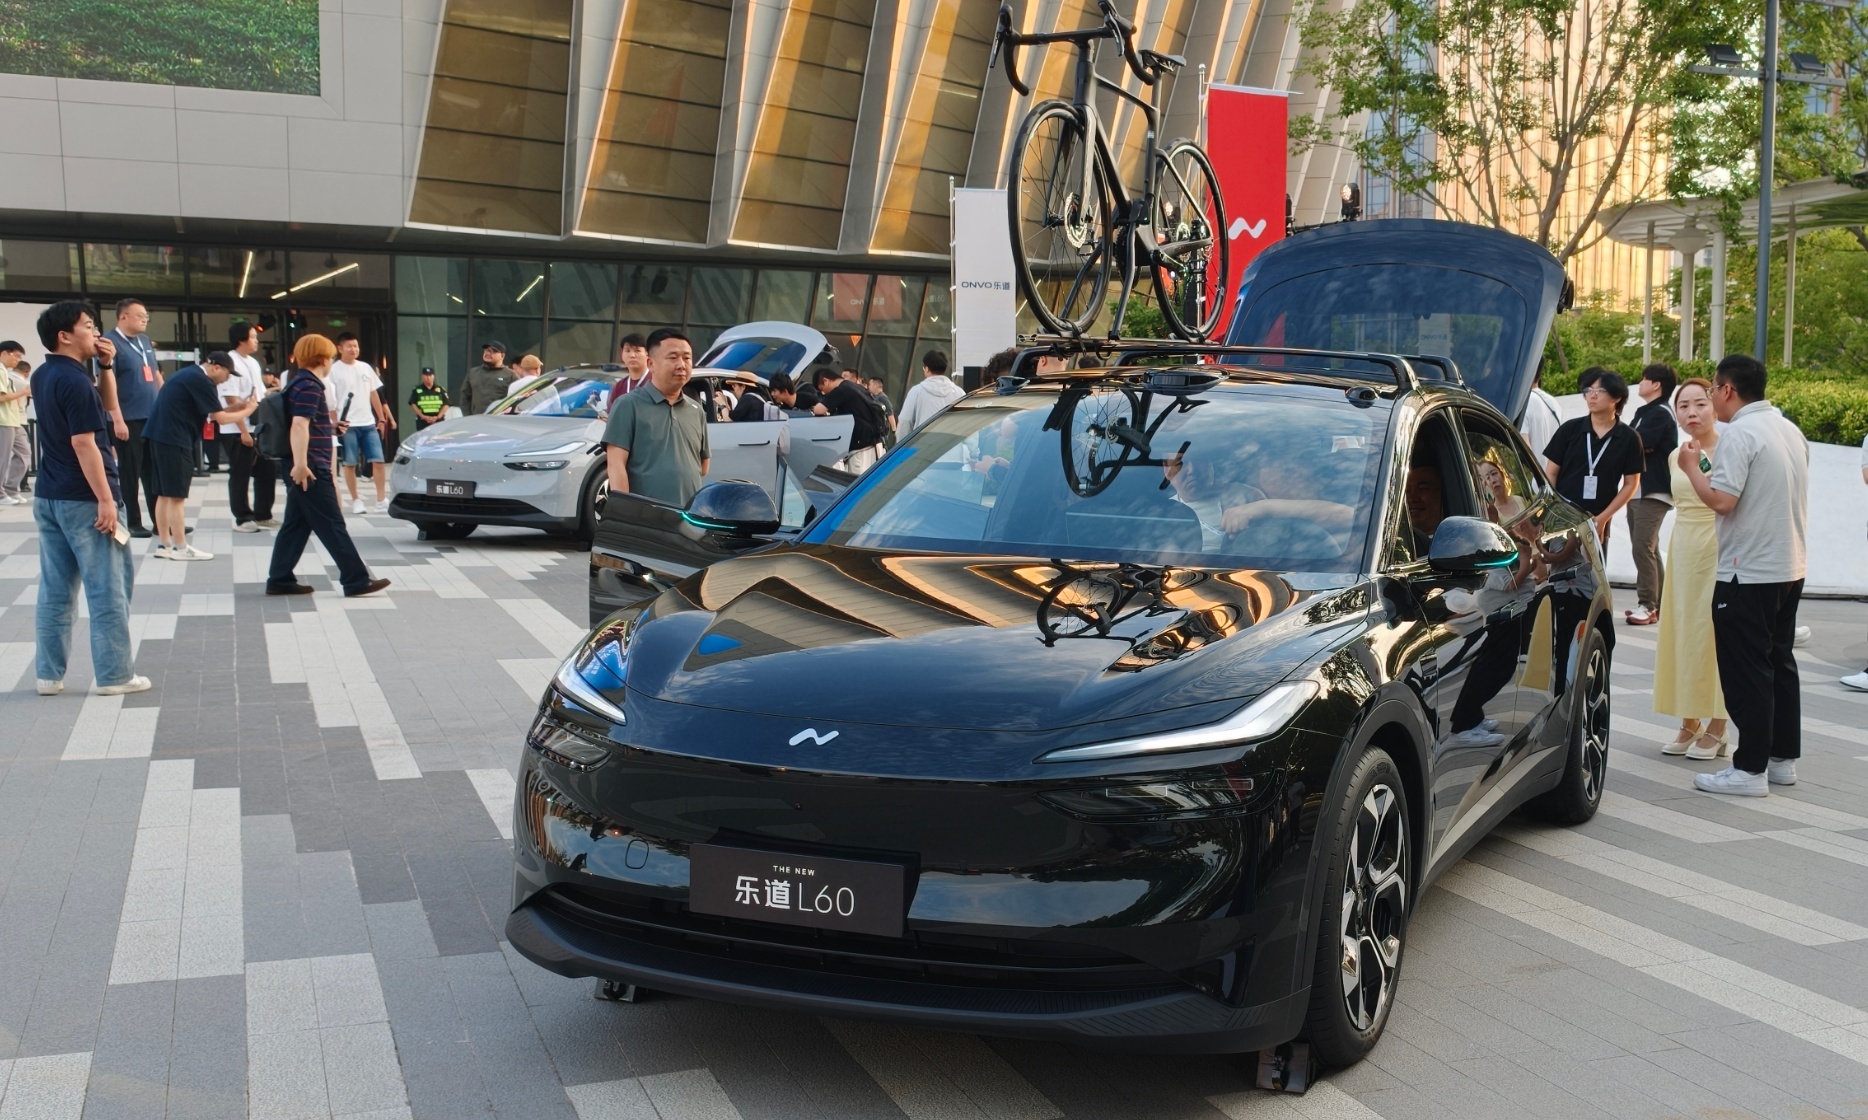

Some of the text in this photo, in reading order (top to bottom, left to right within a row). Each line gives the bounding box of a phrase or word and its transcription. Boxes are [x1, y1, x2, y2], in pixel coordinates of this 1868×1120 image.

[961, 281, 1010, 291] ONVO乐道
[773, 865, 815, 876] THE NEW
[735, 875, 855, 917] 乐道L60
